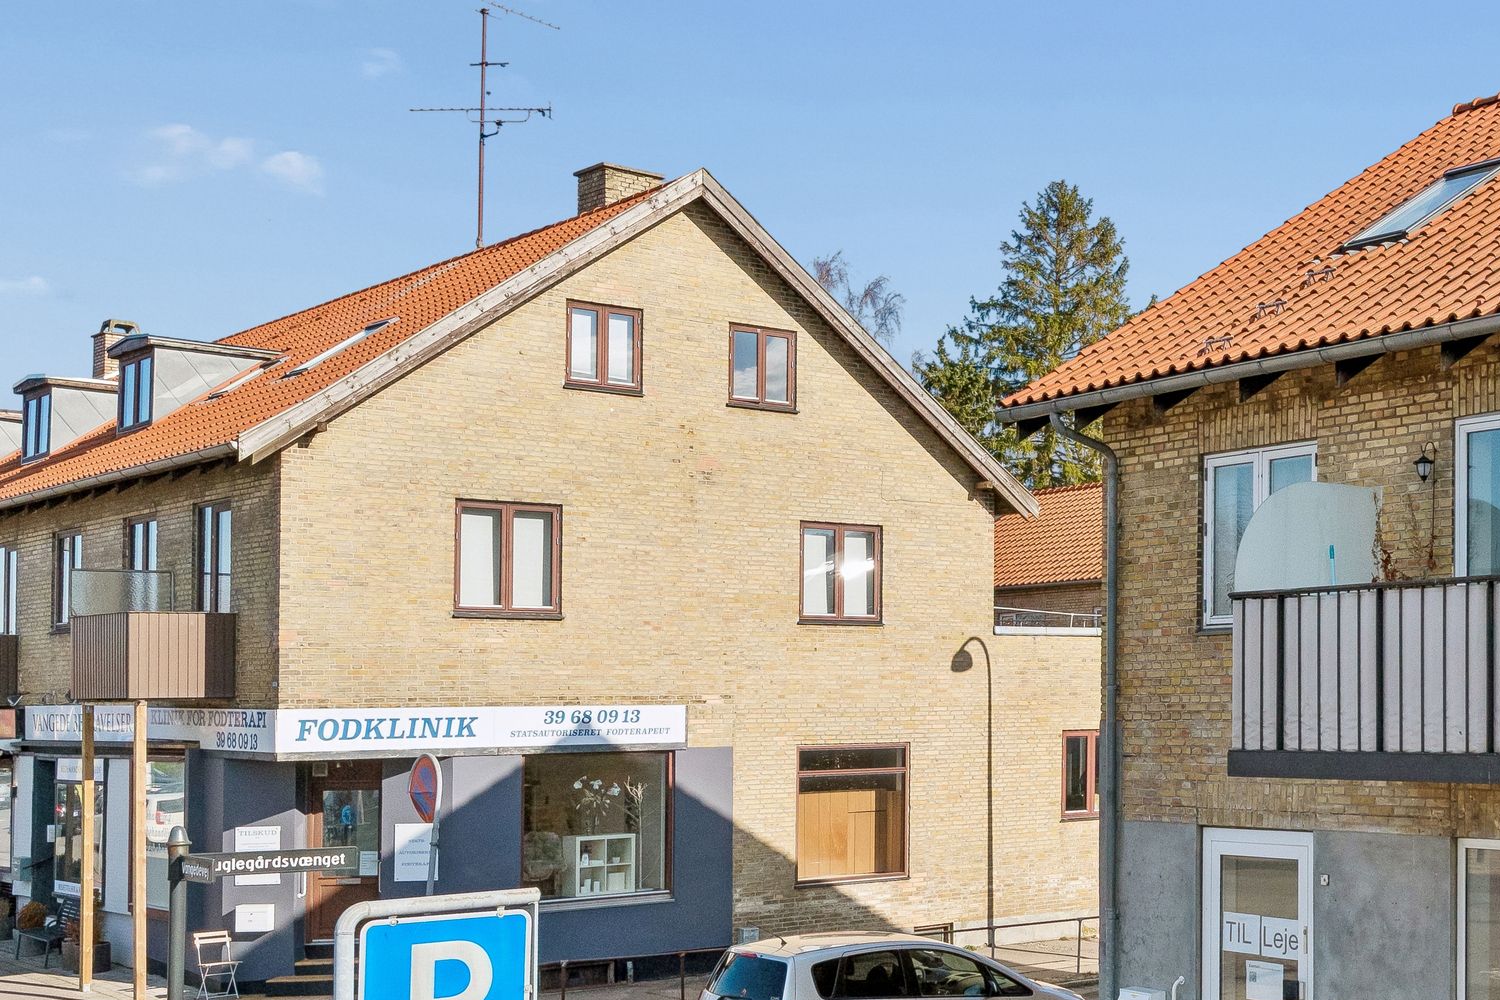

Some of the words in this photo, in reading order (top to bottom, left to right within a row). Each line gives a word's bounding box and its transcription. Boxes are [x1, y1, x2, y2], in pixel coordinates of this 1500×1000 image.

[150, 709, 185, 726] KLINIK
[186, 710, 206, 727] FOR
[208, 710, 267, 728] FODTERAPI
[543, 710, 565, 725] 39
[570, 709, 592, 725] 68
[597, 709, 619, 724] 09
[621, 709, 641, 723] 13
[295, 716, 479, 742] FODKLINIK
[510, 728, 602, 738] STATSAUTORISERET
[606, 727, 671, 736] FODTERAPEUT
[216, 731, 225, 748] 39
[227, 732, 237, 749] 68
[238, 733, 248, 750] 09
[249, 733, 258, 750] 13
[214, 853, 345, 873] uglegårdsvænget
[1225, 920, 1252, 945] TIL
[1263, 925, 1298, 955] Leje
